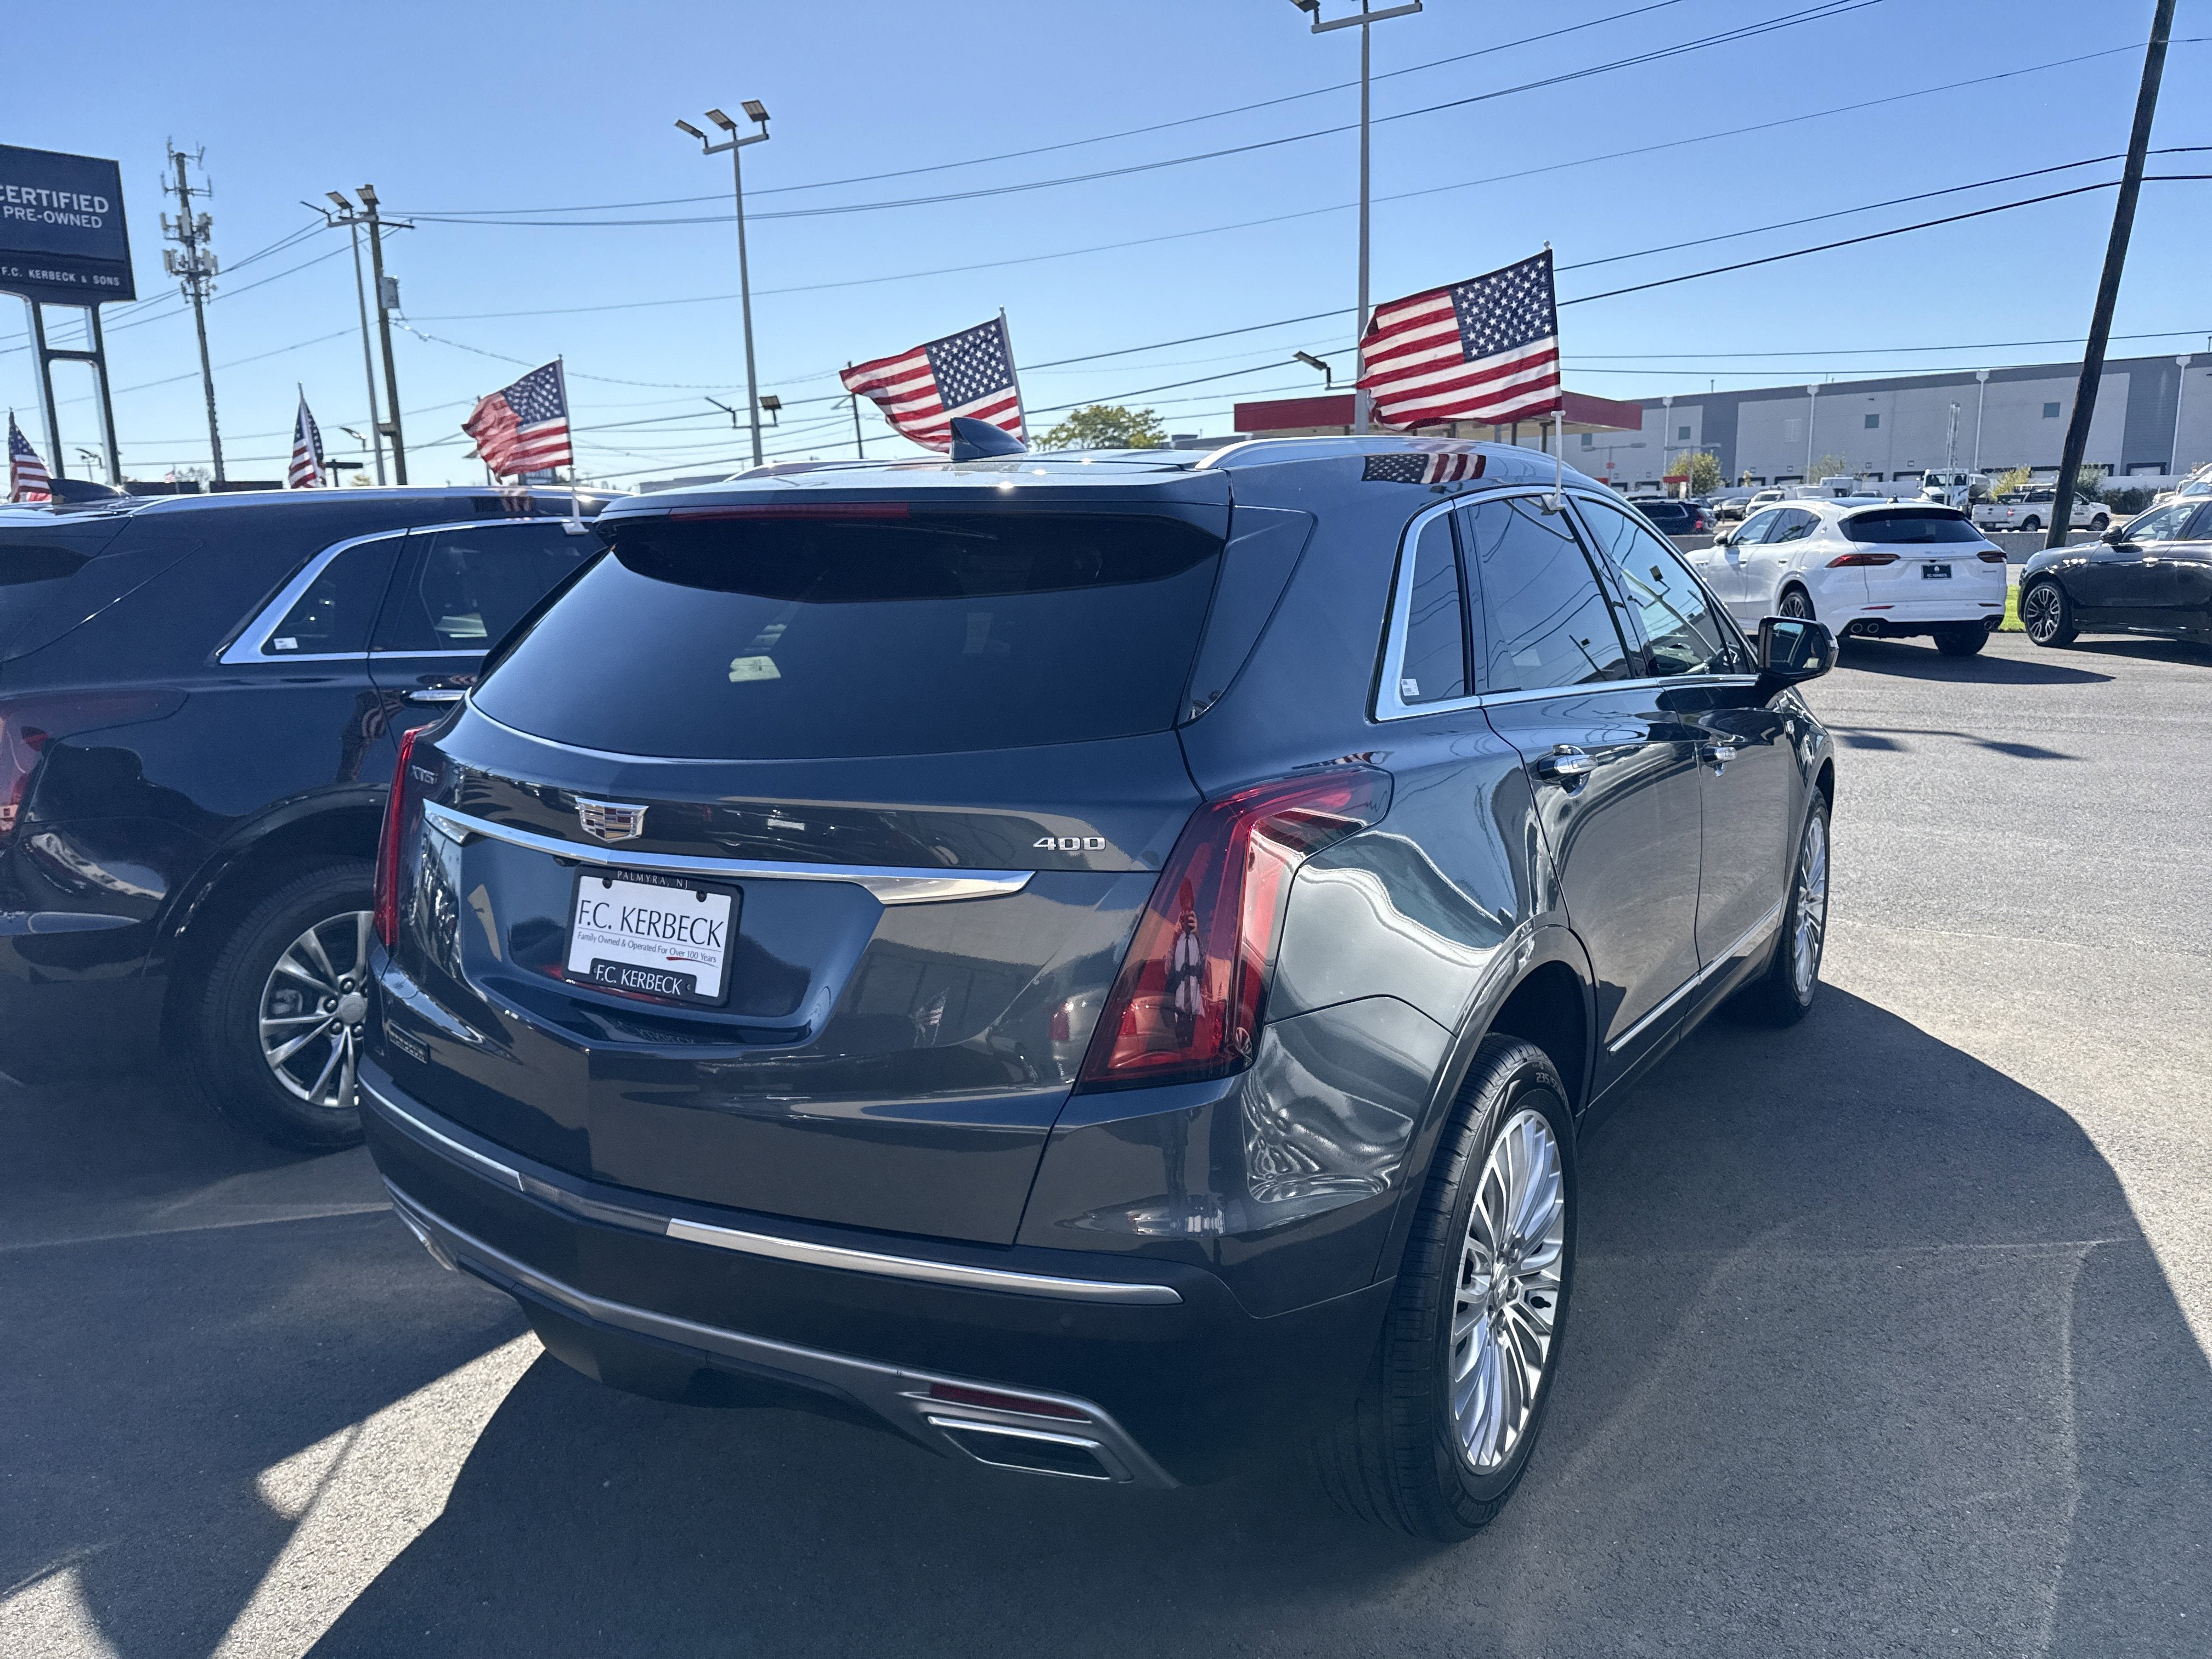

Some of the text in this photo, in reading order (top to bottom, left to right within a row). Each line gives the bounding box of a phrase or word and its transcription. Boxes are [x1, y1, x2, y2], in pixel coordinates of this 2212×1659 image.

[3, 205, 102, 229] PRE-OWNED
[29, 268, 76, 283] KERBECK
[93, 275, 120, 286] SONS
[1032, 837, 1106, 851] 400
[617, 870, 689, 889] PALMYRA, NJ
[578, 900, 725, 948] F.C. KERBECK
[578, 931, 716, 963] Family Owned & Operated For Over 100 Years
[595, 964, 684, 996] F.C. KERBECK
